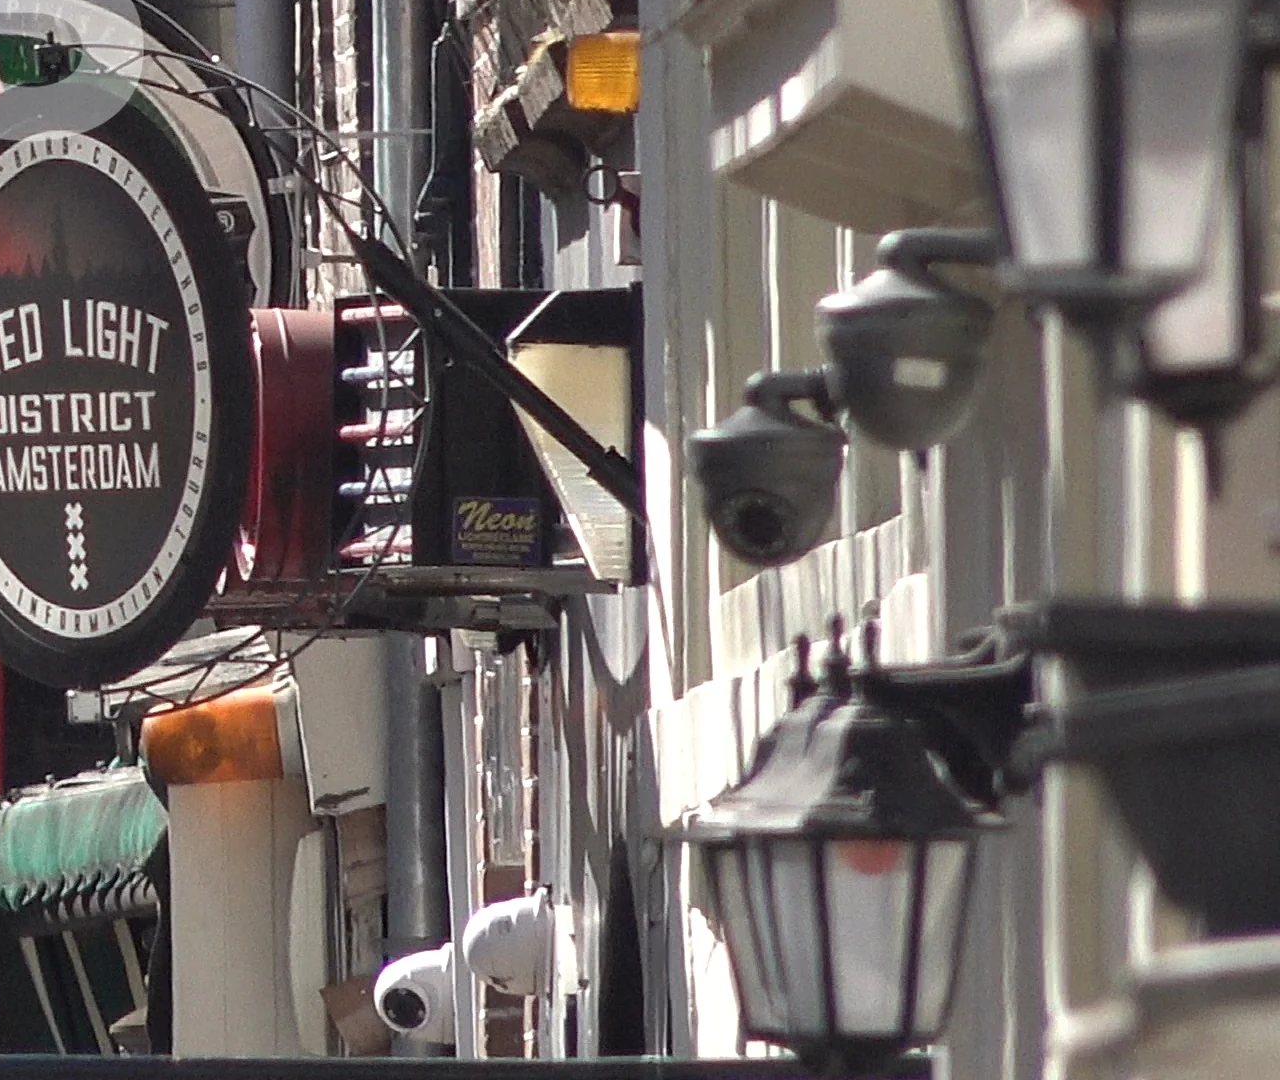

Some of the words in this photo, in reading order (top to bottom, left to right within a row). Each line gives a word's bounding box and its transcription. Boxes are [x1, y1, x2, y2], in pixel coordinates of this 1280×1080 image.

[13, 137, 70, 169] BARS
[62, 298, 170, 374] LIGHT
[15, 567, 164, 633] INFORMATION
[174, 430, 207, 540] TOURS
